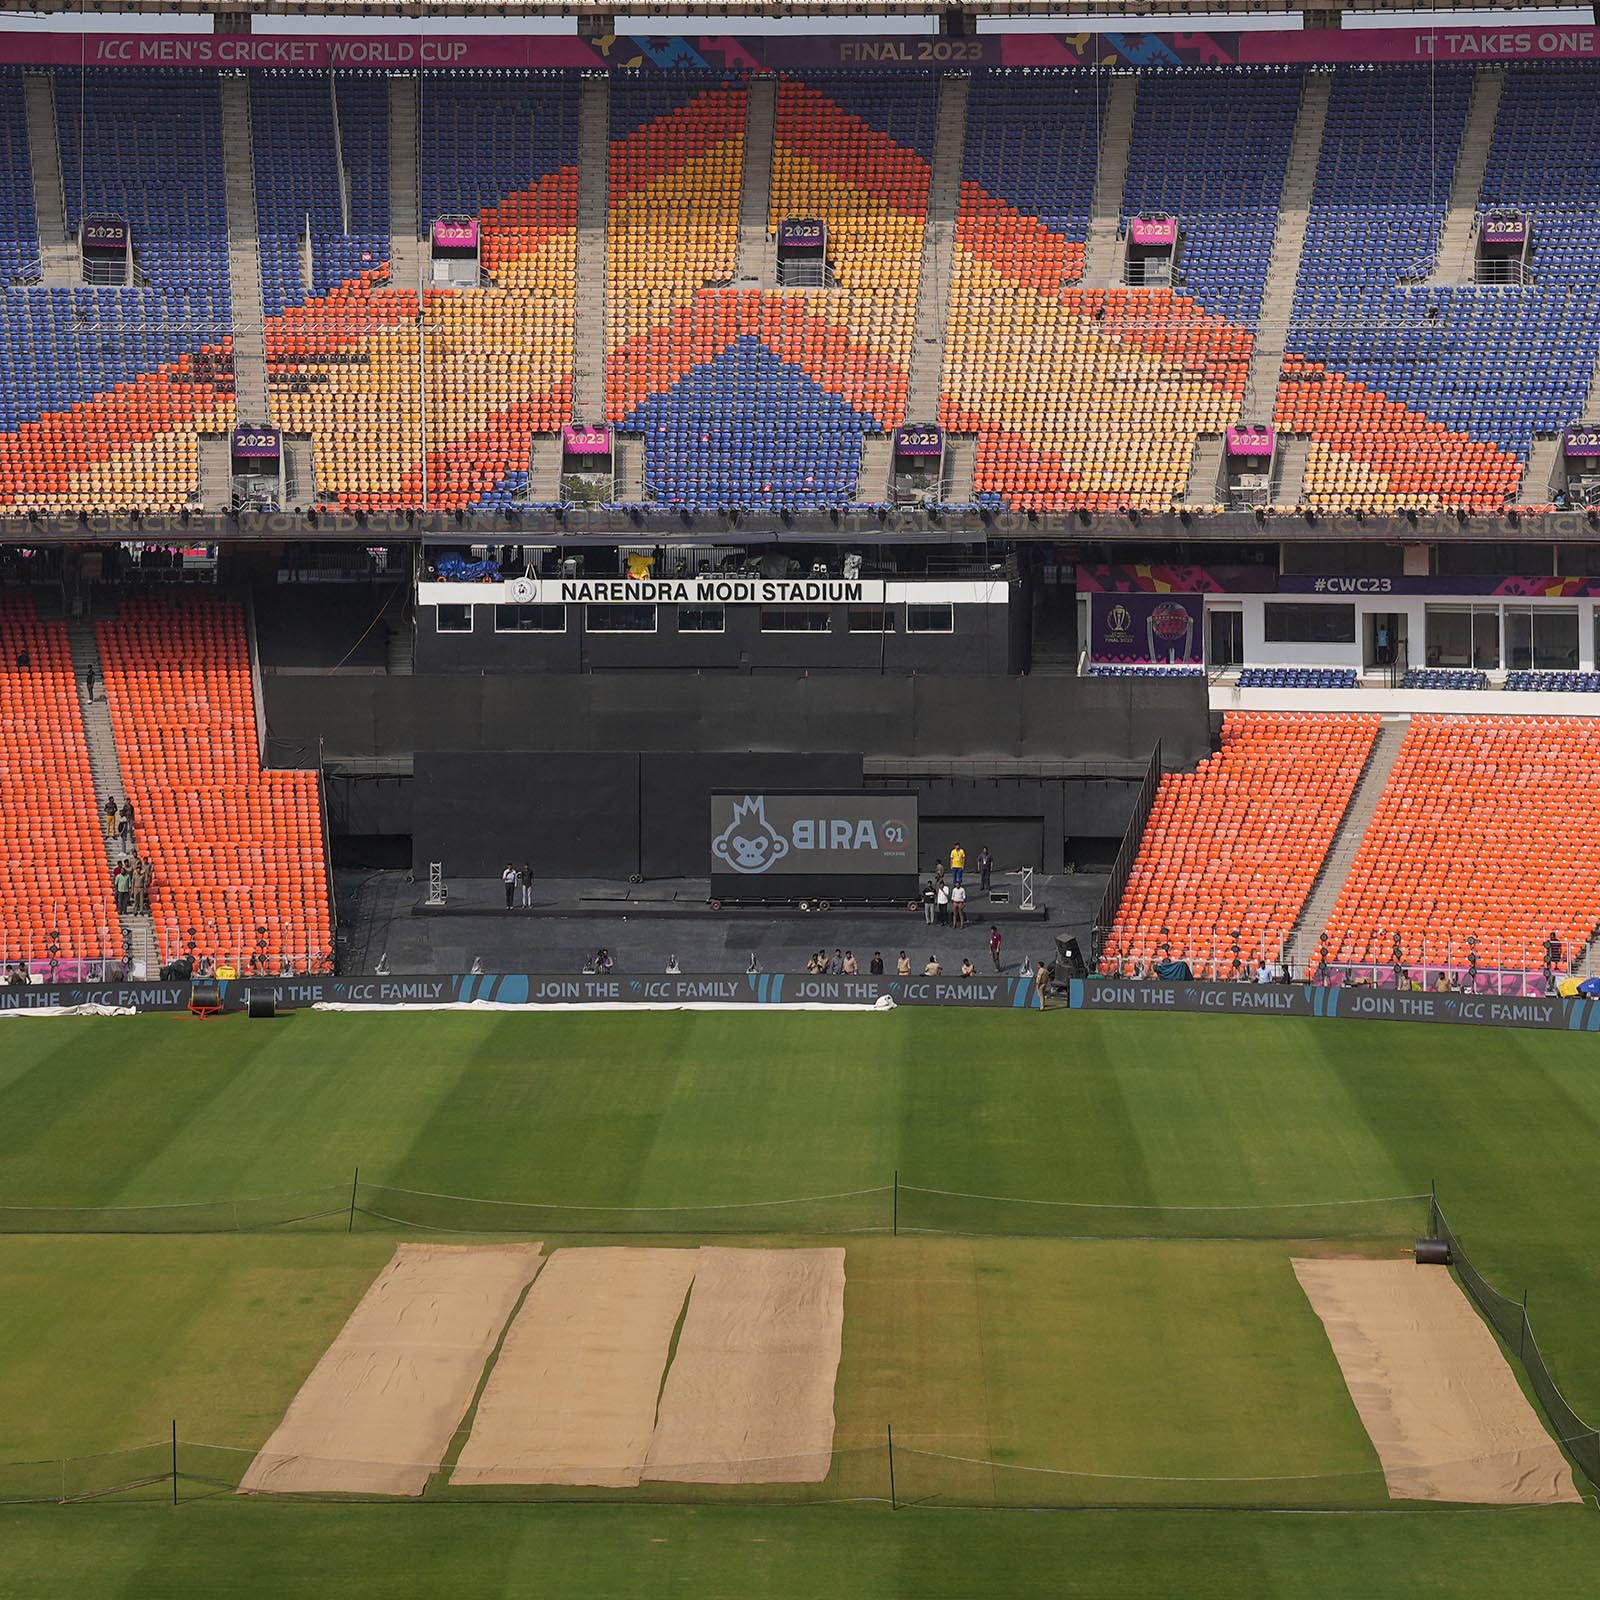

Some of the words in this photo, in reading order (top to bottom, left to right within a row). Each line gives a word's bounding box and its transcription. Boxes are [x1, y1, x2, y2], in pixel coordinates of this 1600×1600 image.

[97, 41, 134, 60] ICC
[139, 41, 213, 61] MEN'S
[218, 42, 319, 61] CRICKET
[326, 42, 414, 61] WORLD
[420, 42, 468, 61] CUP
[840, 42, 912, 61] FINAL
[917, 41, 983, 61] 2023
[1415, 35, 1435, 54] IT
[1445, 34, 1531, 53] TAKES
[1538, 33, 1593, 53] ONE
[239, 513, 358, 532] WORLD
[367, 513, 432, 532] CUP
[562, 583, 689, 601] NARENDRA
[697, 583, 755, 601] MODI
[762, 583, 863, 601] STADIUM
[1314, 578, 1392, 593] #CWC23
[792, 820, 878, 849] BIRA
[885, 827, 904, 843] 91
[26, 993, 60, 1007] THE
[85, 991, 112, 1005] ICC
[118, 990, 182, 1005] FAMILY
[240, 987, 287, 1002] JN
[291, 986, 323, 1000] THE
[347, 984, 374, 999] ICC
[380, 983, 442, 998] FAMILY
[536, 982, 581, 998] JOIN
[585, 982, 619, 997] THE
[644, 982, 670, 997] ICC
[676, 982, 739, 997] FAMILY
[795, 982, 841, 998] JOIN
[845, 983, 878, 998] THE
[903, 984, 930, 999] ICC
[936, 985, 998, 1000] FAMILY
[1091, 988, 1135, 1003] JOIN
[1140, 989, 1175, 1005] THE
[1200, 991, 1226, 1006] ICC
[1232, 992, 1294, 1008] FAMILY
[1351, 999, 1395, 1014] JOIN
[1400, 1001, 1434, 1016] THE
[1458, 1002, 1485, 1018] ICC
[1491, 1004, 1553, 1021] FAMILY
